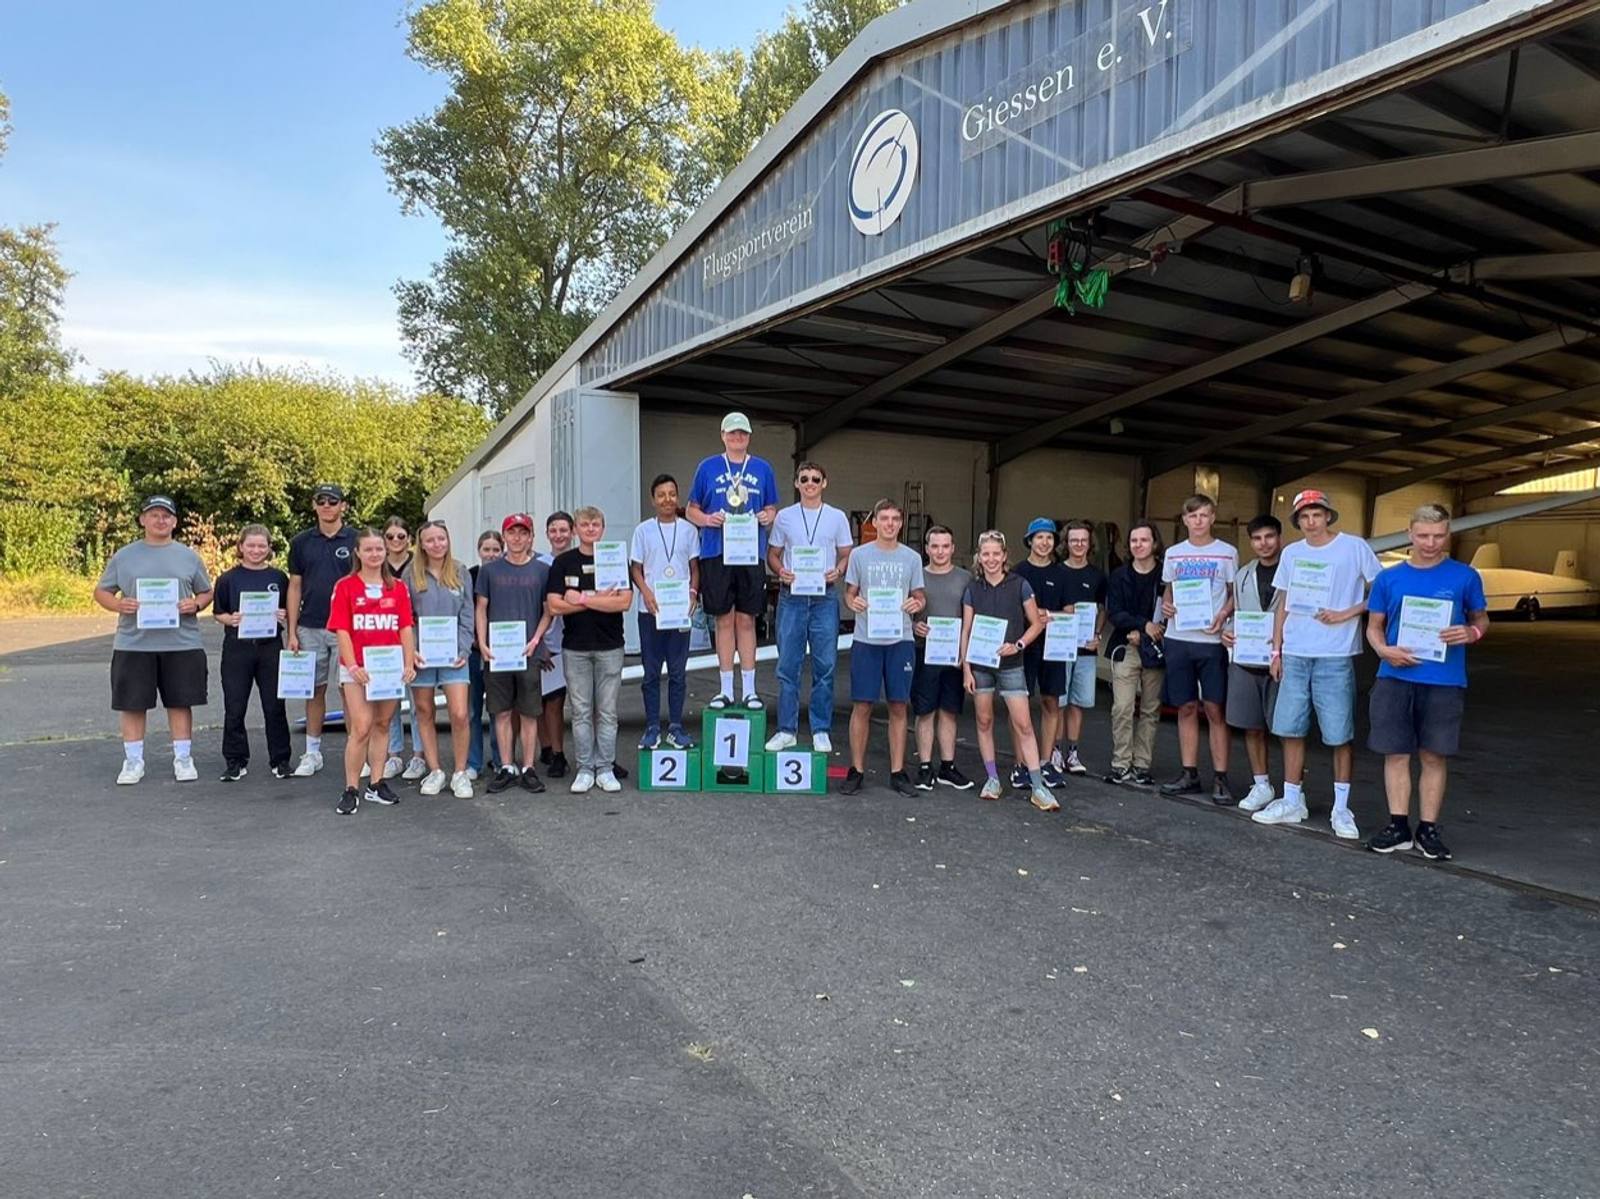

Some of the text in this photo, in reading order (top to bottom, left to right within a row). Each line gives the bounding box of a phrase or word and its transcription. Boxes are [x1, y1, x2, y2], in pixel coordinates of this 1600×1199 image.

[702, 0, 1172, 281] Flugsportverein Giessen e. V.
[353, 613, 399, 631] REWE
[723, 733, 736, 758] 1
[659, 757, 677, 782] 2
[784, 759, 803, 785] 3
